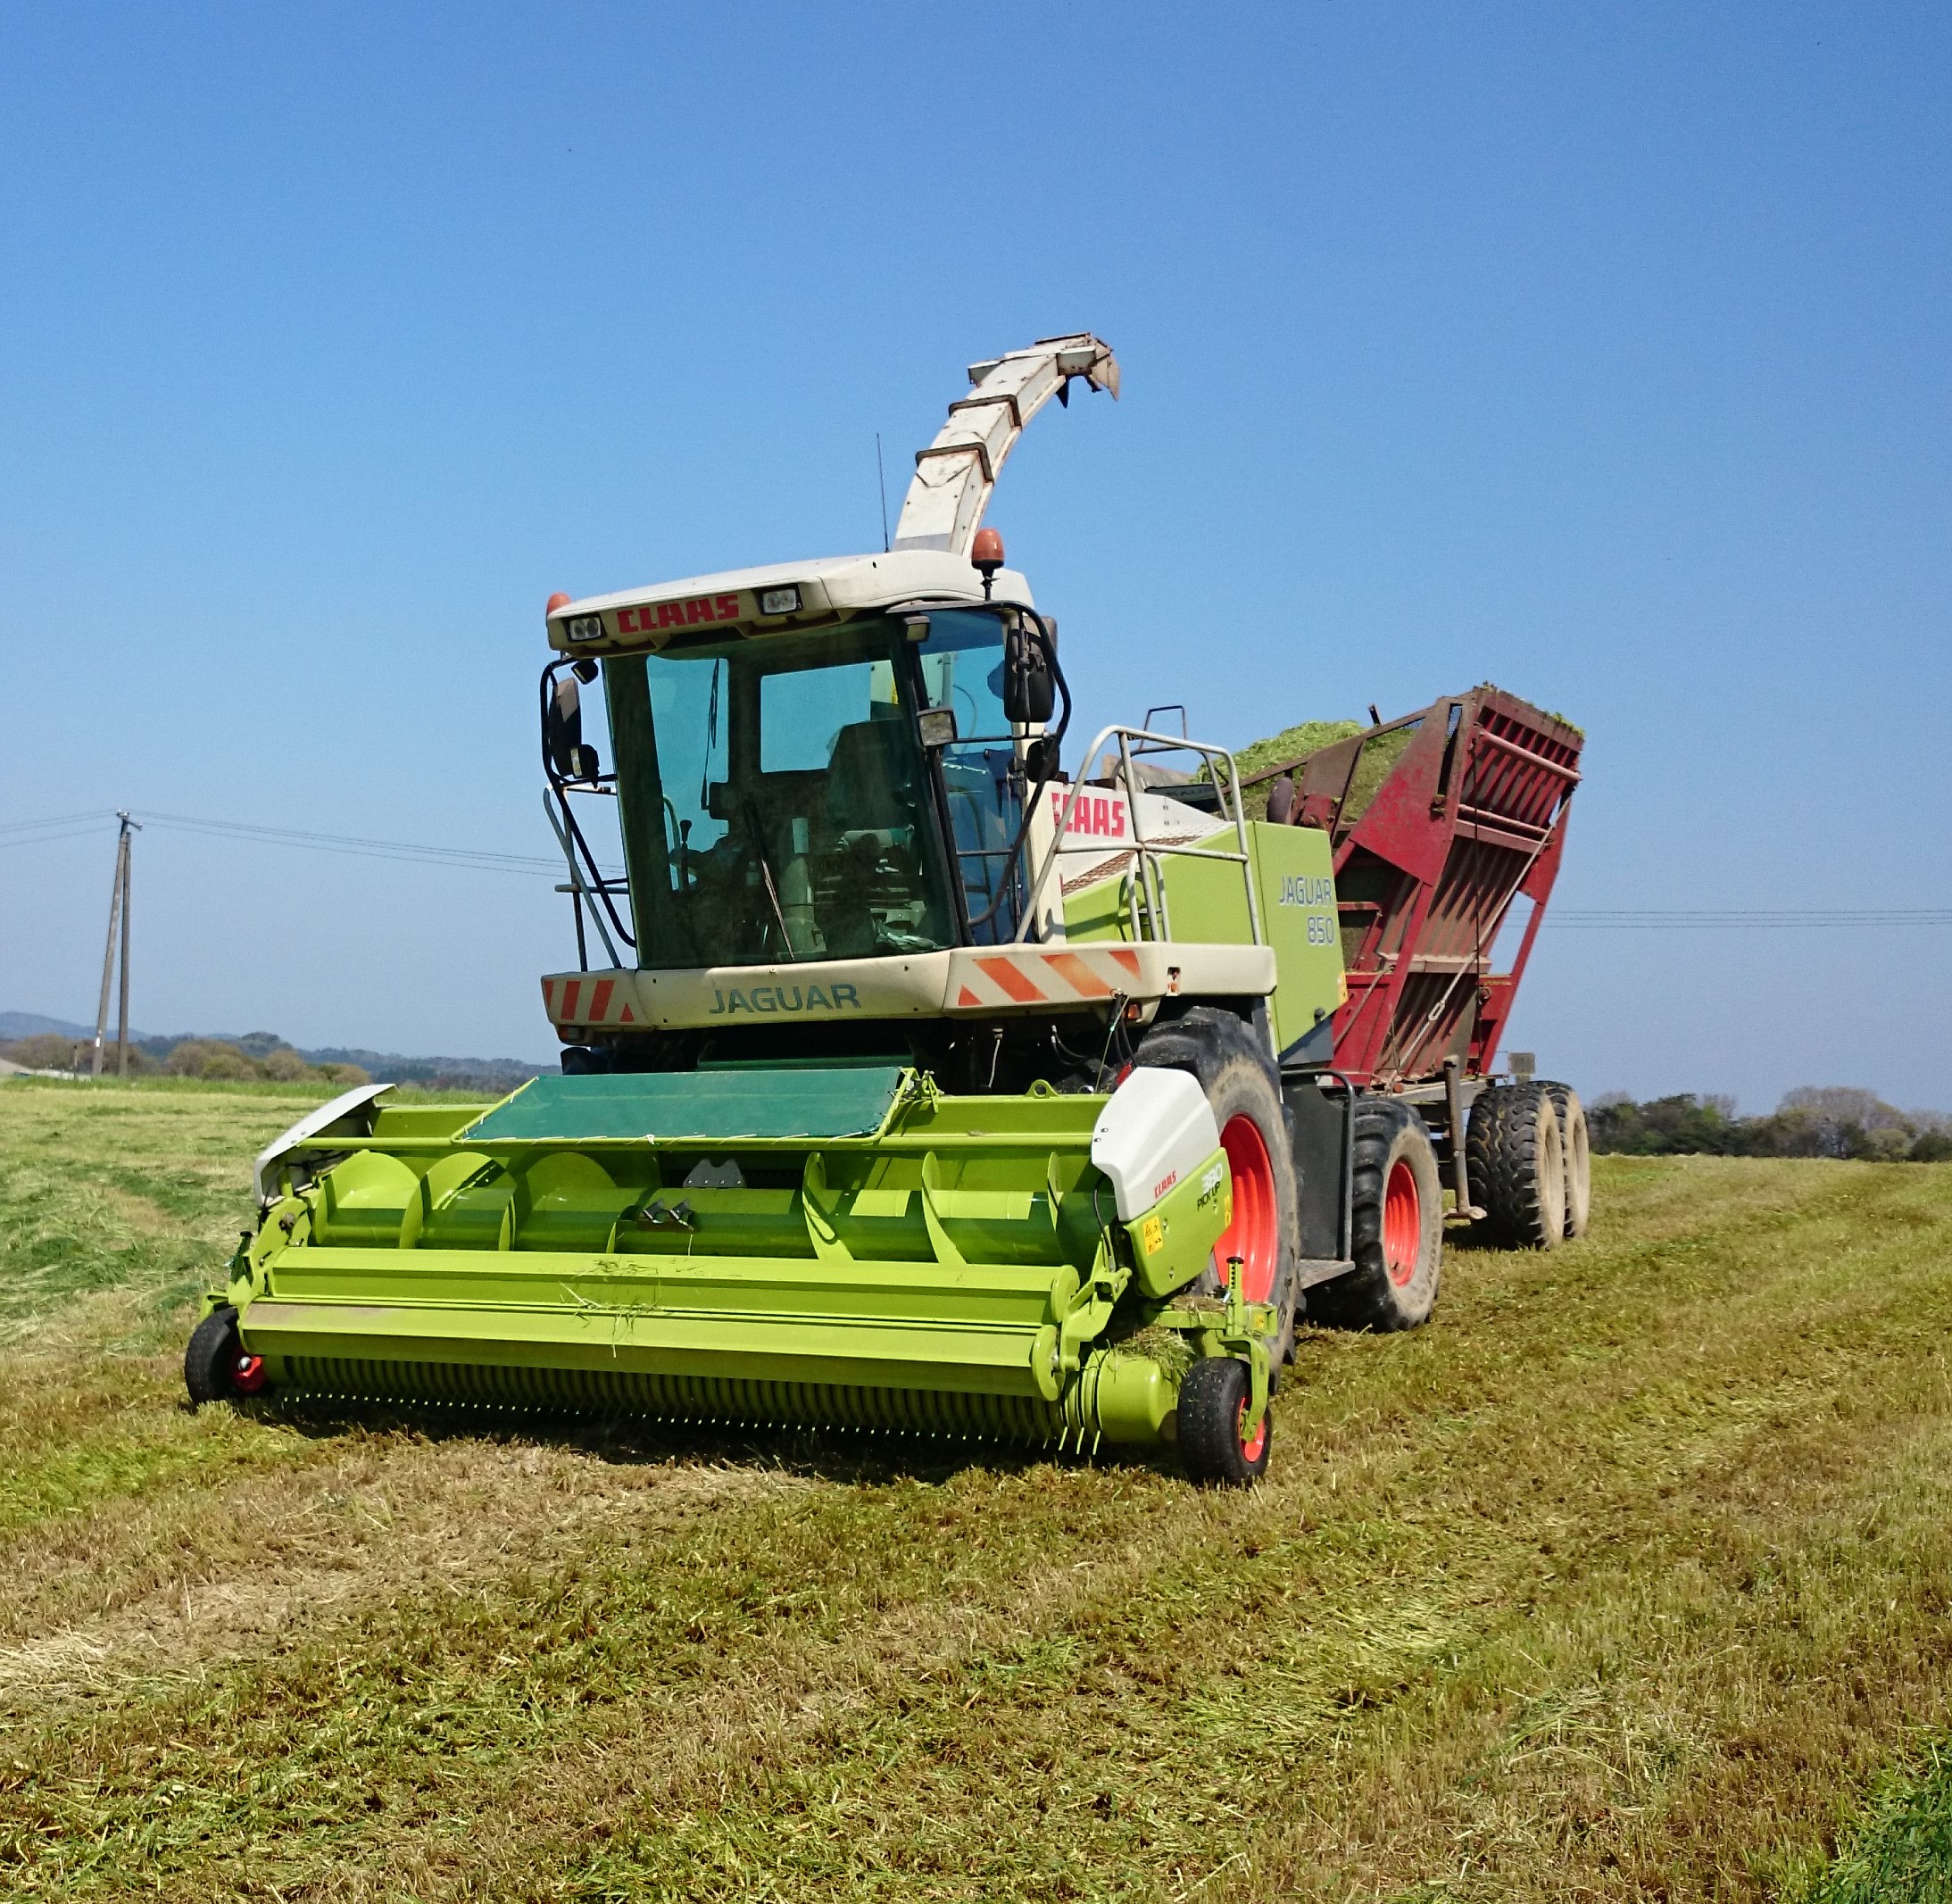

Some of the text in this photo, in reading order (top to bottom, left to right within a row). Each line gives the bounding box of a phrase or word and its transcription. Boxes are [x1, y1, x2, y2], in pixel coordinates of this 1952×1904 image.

[617, 594, 740, 634] CLAAS
[1279, 876, 1333, 906] JAGUAR
[1307, 916, 1334, 944] 850
[709, 984, 861, 1014] JAGUAR
[1154, 1170, 1176, 1199] CLAAS
[1202, 1163, 1223, 1193] 380
[1197, 1181, 1221, 1211] PICK UP
